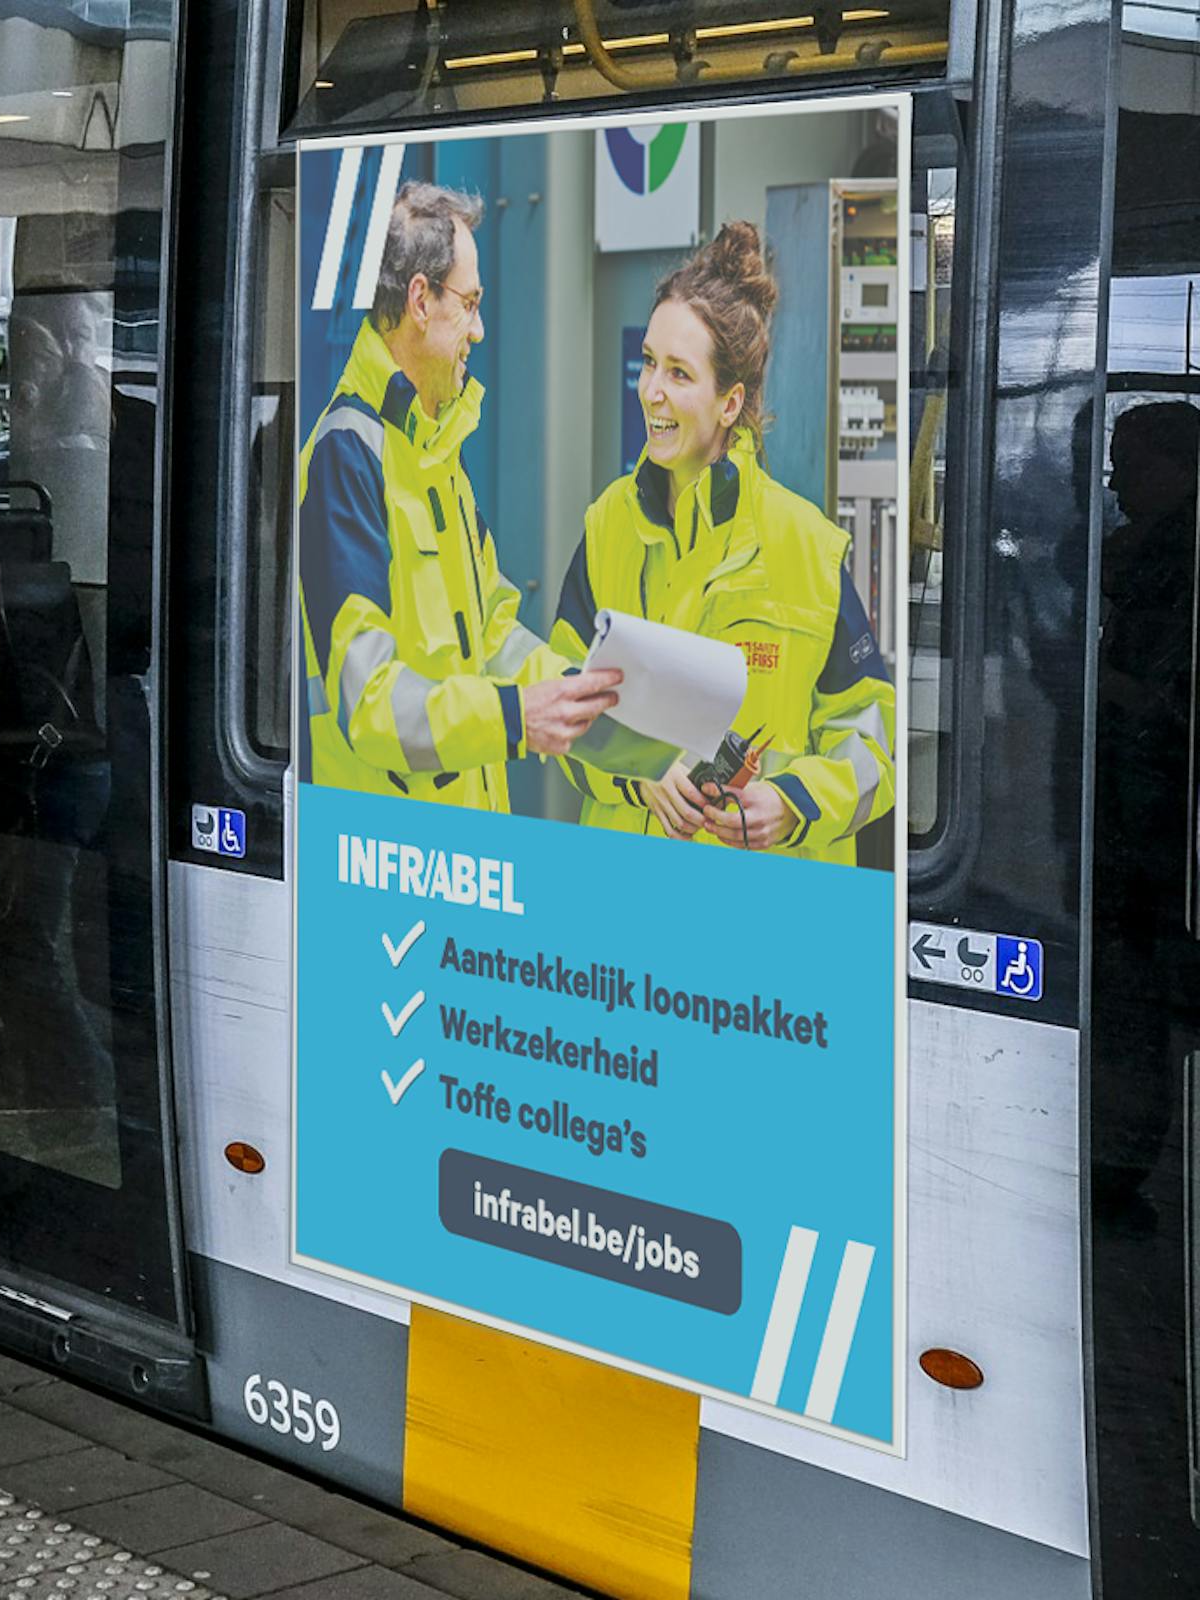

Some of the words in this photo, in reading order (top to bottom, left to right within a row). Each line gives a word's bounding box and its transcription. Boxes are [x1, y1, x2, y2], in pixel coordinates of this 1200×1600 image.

[751, 653, 779, 669] FIRST
[439, 937, 636, 1012] Aantrekkelijk
[643, 973, 829, 1049] loonpakket
[439, 1004, 659, 1088] Werkzekerheid
[439, 1073, 512, 1124] Toffe
[517, 1100, 648, 1159] collega's
[473, 1180, 701, 1279] infrabel.be/jobs
[244, 1373, 341, 1451] 6359
